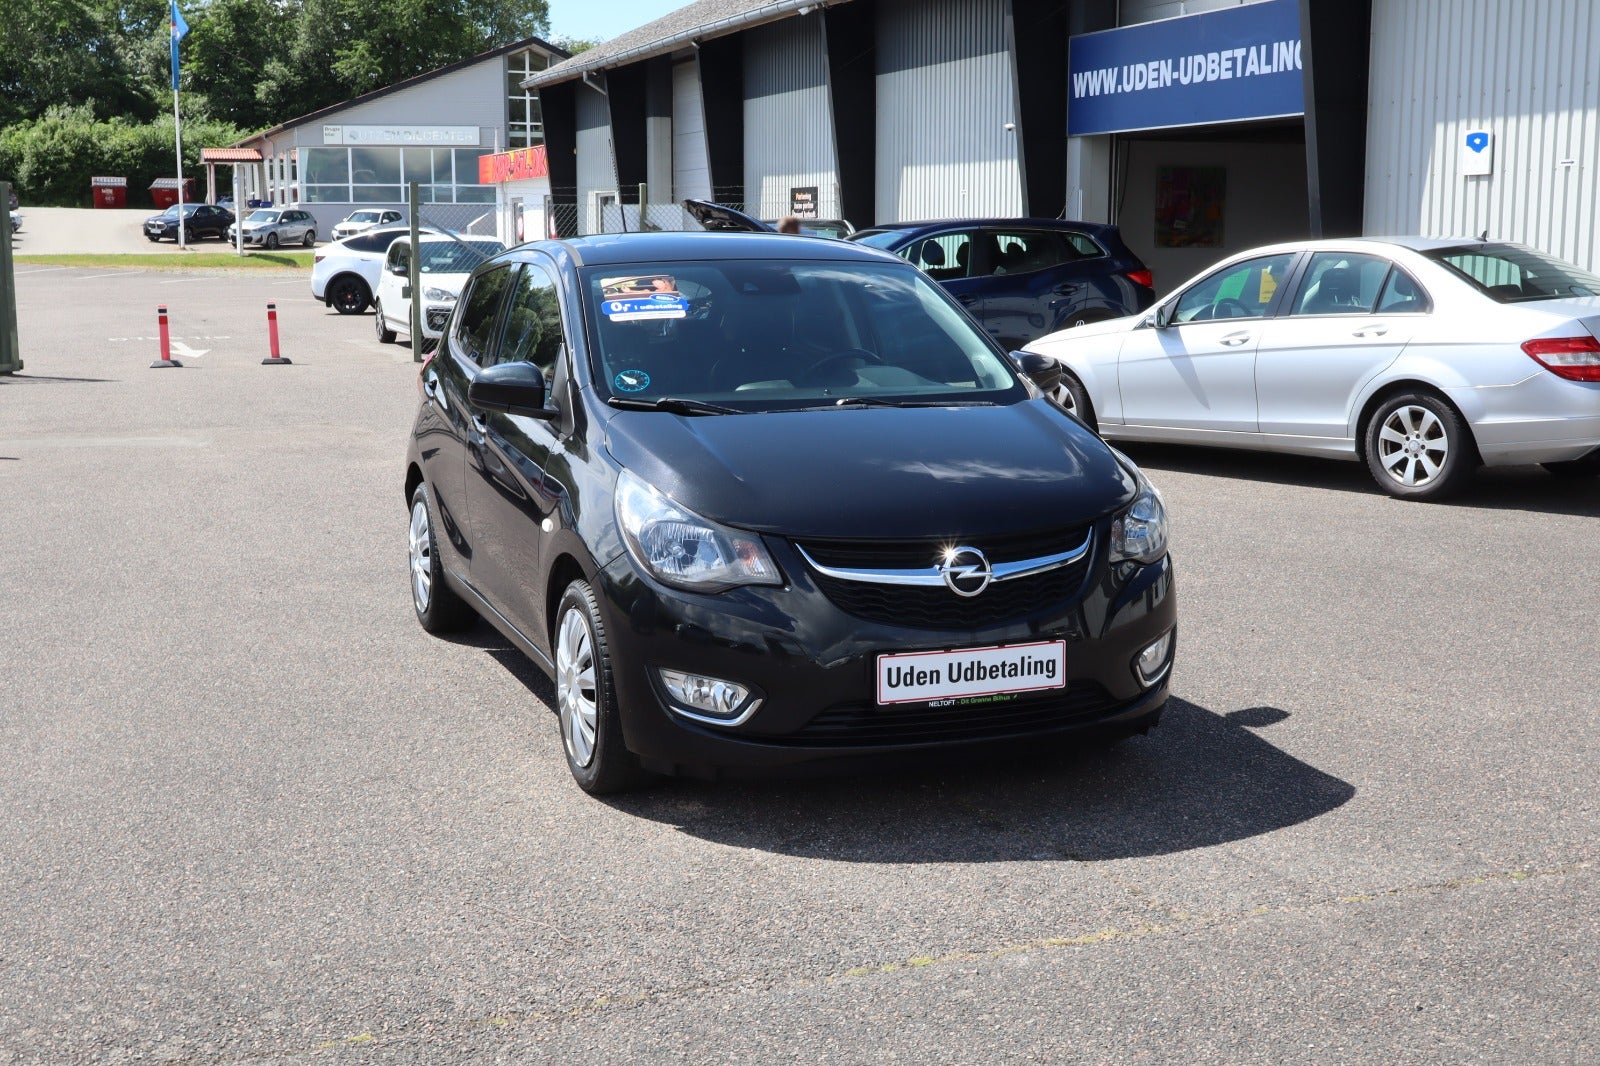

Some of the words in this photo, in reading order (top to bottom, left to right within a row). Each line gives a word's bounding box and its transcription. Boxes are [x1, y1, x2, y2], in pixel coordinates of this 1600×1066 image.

[887, 665, 941, 688] Uden
[948, 655, 1057, 683] Udbetaling
[928, 699, 955, 708] NELTOFT
